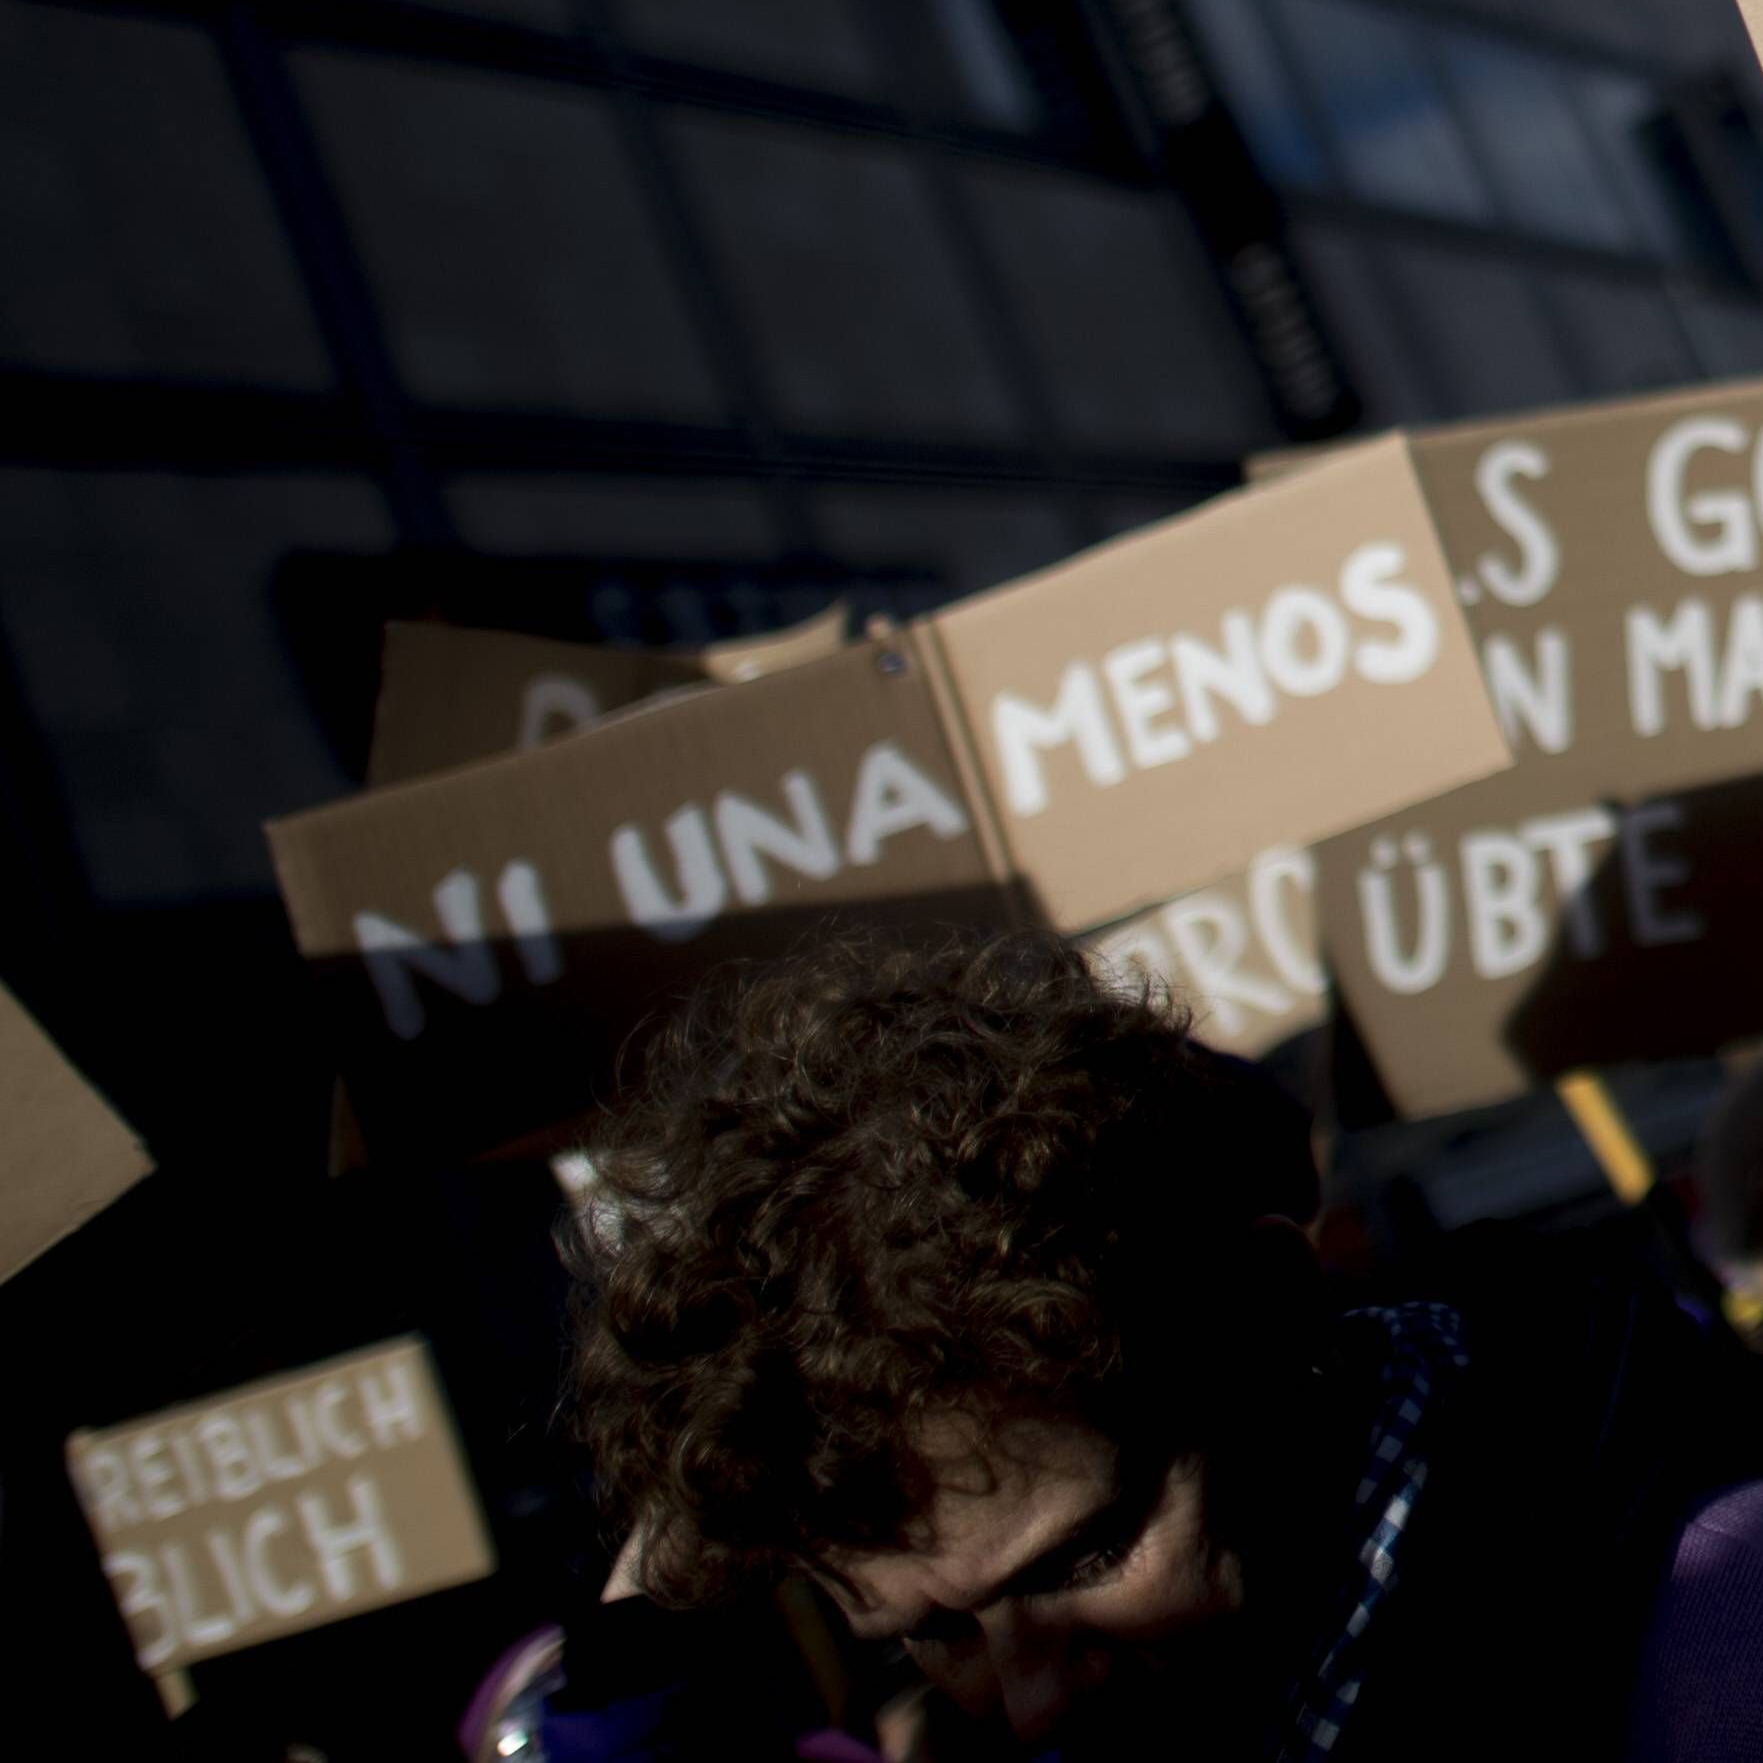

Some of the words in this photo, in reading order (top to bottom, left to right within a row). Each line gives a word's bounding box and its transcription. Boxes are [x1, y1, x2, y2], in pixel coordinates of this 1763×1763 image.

[353, 857, 567, 1043] NI
[610, 739, 970, 945] UNA
[988, 540, 1440, 817] MENOS
[1357, 799, 1711, 998] ÜBTE
